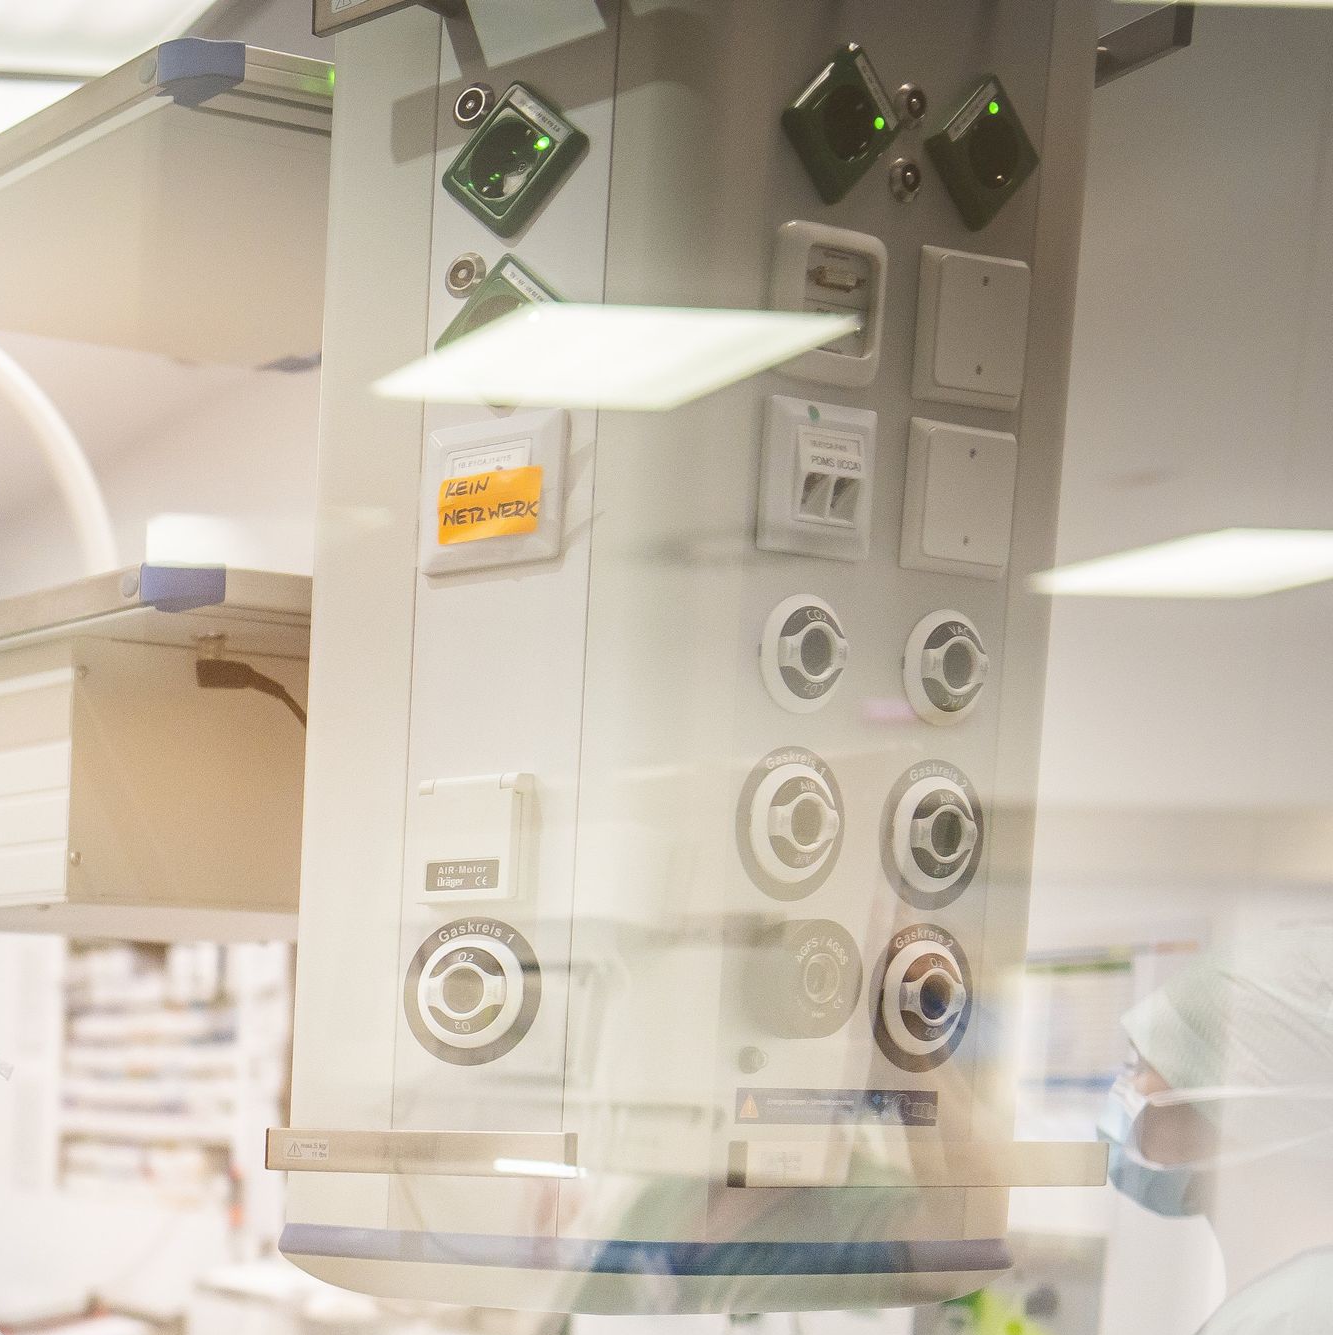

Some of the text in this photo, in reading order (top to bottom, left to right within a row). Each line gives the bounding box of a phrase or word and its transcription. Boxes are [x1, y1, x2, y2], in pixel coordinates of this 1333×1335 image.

[445, 476, 490, 498] KEIN
[443, 500, 540, 526] NETZWERK
[948, 625, 971, 638] VAC
[765, 750, 817, 770] Gaskreis
[909, 763, 959, 783] Gaskreis
[800, 781, 817, 792] AIR
[940, 794, 956, 805] AIR
[437, 865, 487, 875] AIR-Motor
[437, 876, 464, 888] Dräger
[438, 921, 516, 944] Gaskreis 1
[895, 928, 954, 949] Gaskreis 2
